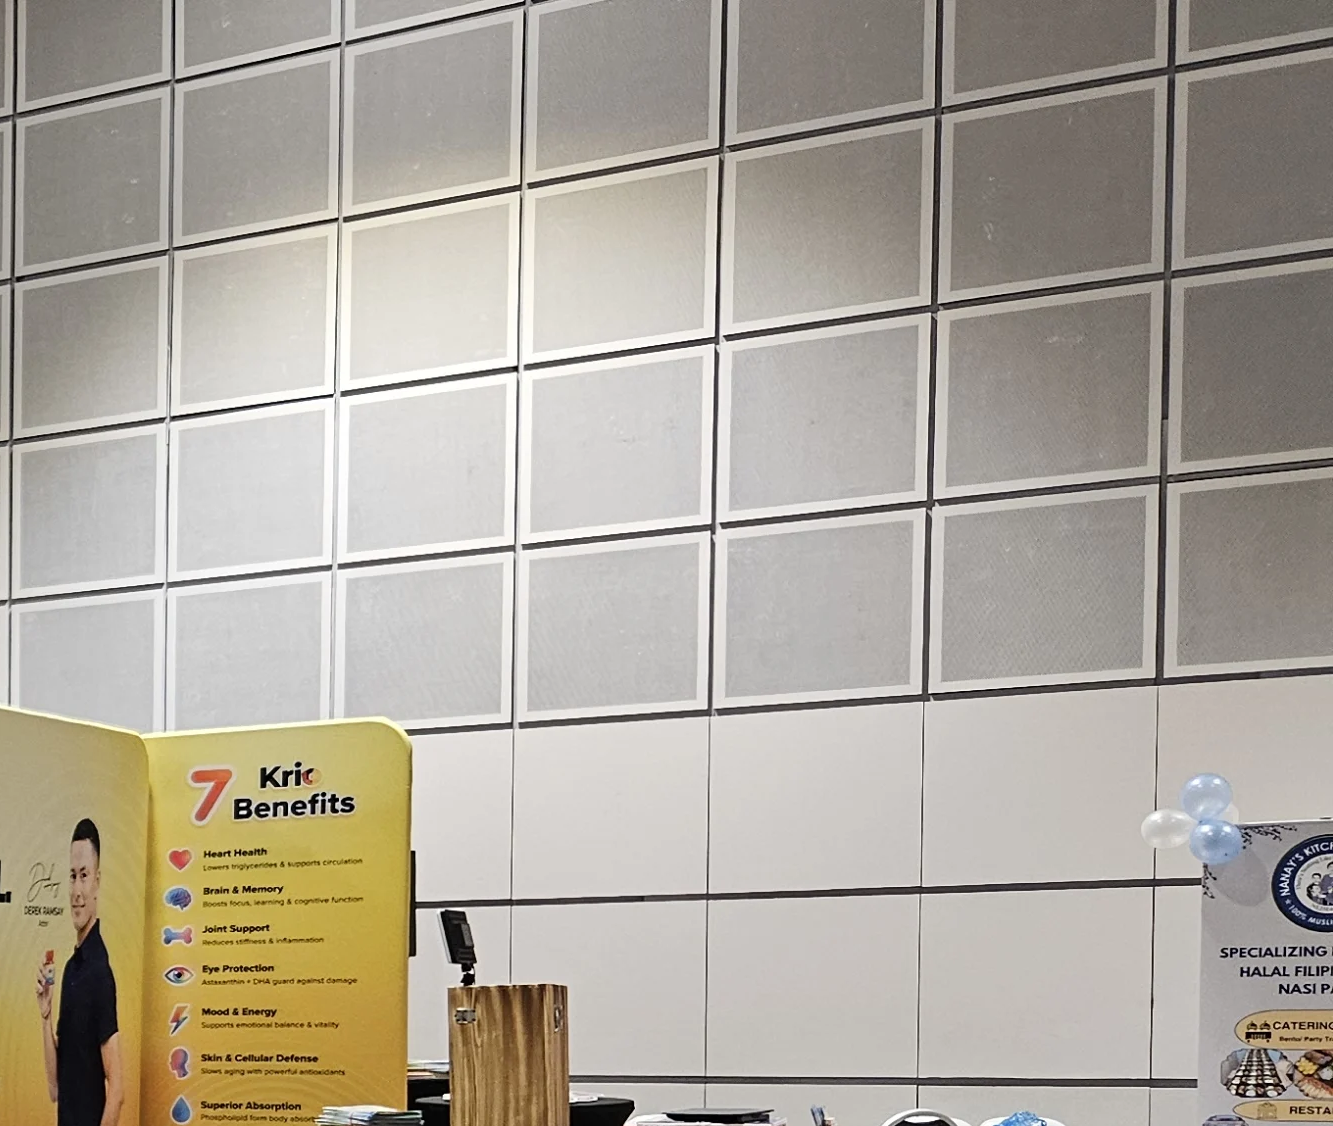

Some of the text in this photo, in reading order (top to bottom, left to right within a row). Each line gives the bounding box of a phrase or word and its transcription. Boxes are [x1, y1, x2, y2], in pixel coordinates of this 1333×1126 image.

[191, 768, 233, 822] 7
[234, 792, 355, 820] Benefits
[203, 848, 267, 858] Heart Health
[232, 858, 362, 871] triglycerides supports circulation
[1279, 853, 1304, 896] NANAY'S
[203, 885, 283, 895] Brain & Memory
[294, 897, 329, 906] cognitive
[202, 924, 270, 934] Joint Support
[1219, 946, 1328, 958] SPECIALIZING
[202, 964, 274, 975] Eye Protection
[1240, 966, 1290, 977] HALAL
[273, 978, 295, 986] guard
[297, 977, 324, 985] against
[326, 977, 358, 985] damage
[1278, 983, 1316, 994] NASI
[202, 1008, 277, 1017] Mood & Energy
[201, 1054, 318, 1063] Skin & Cellular Defense
[264, 1068, 297, 1076] powerful
[201, 1101, 301, 1111] Superior Absorption
[1289, 1106, 1333, 1114] RESTA
